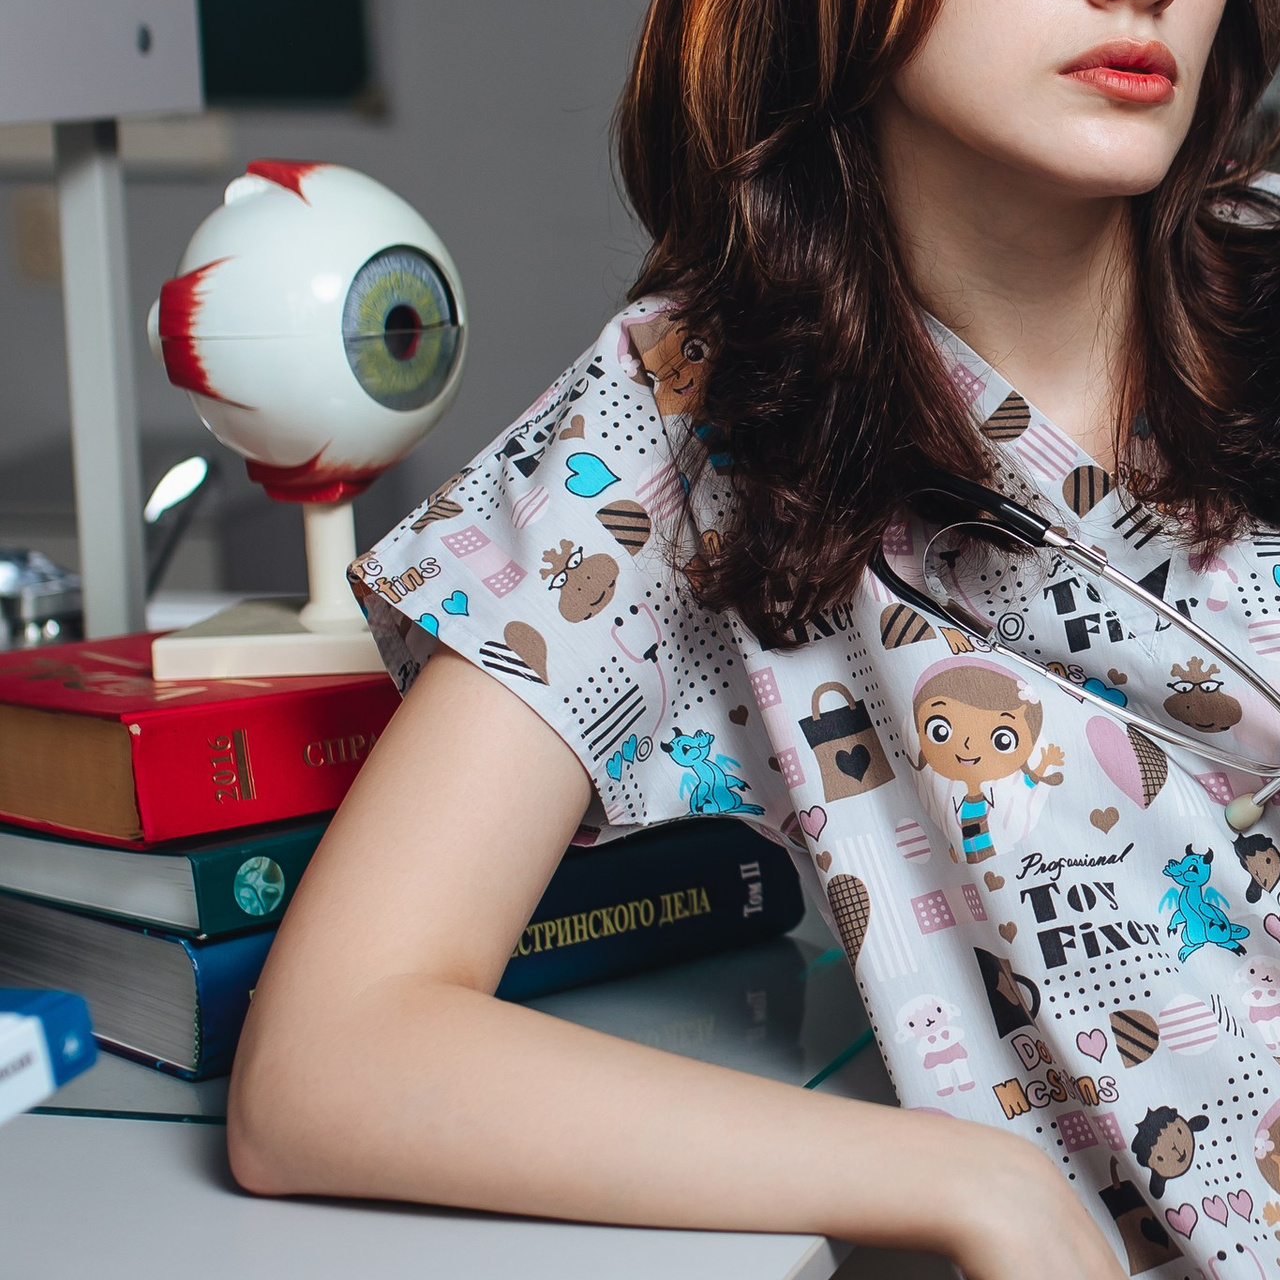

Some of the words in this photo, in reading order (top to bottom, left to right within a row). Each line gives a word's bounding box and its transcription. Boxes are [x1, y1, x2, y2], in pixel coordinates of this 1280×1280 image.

[208, 735, 239, 804] 2016
[659, 887, 711, 927] ДЕЛА
[1020, 882, 1118, 923] Toy
[1037, 920, 1160, 969] Fixer
[1011, 1033, 1056, 1071] Do
